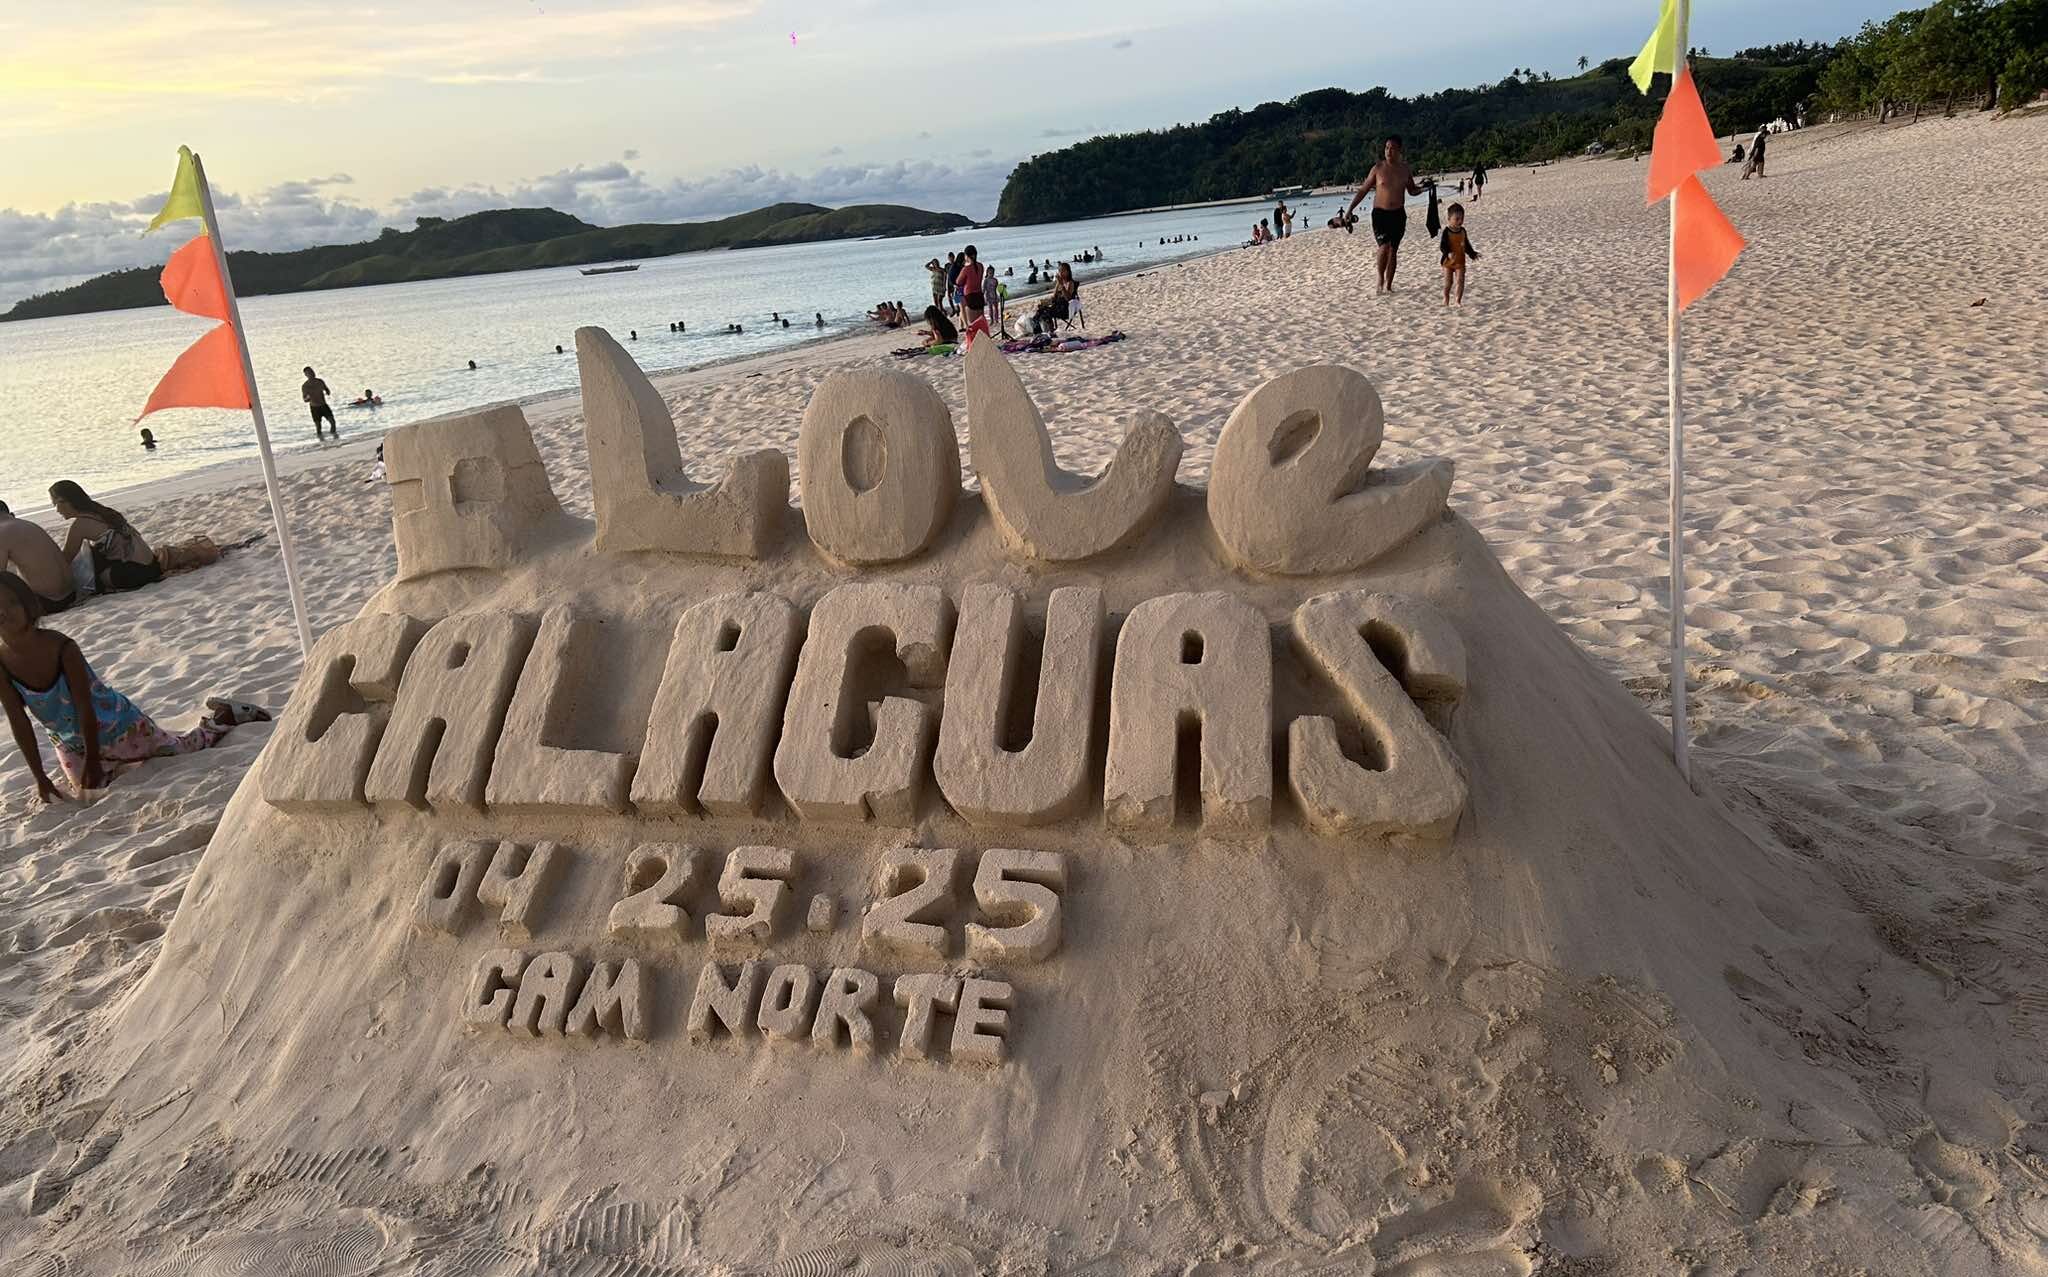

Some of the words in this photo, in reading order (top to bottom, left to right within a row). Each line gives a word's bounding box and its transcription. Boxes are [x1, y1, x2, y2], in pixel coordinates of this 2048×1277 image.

[262, 582, 1467, 836] CALAGUAS
[412, 840, 566, 938] 04
[463, 948, 648, 1042] CAM
[688, 958, 1014, 1064] NORTE
